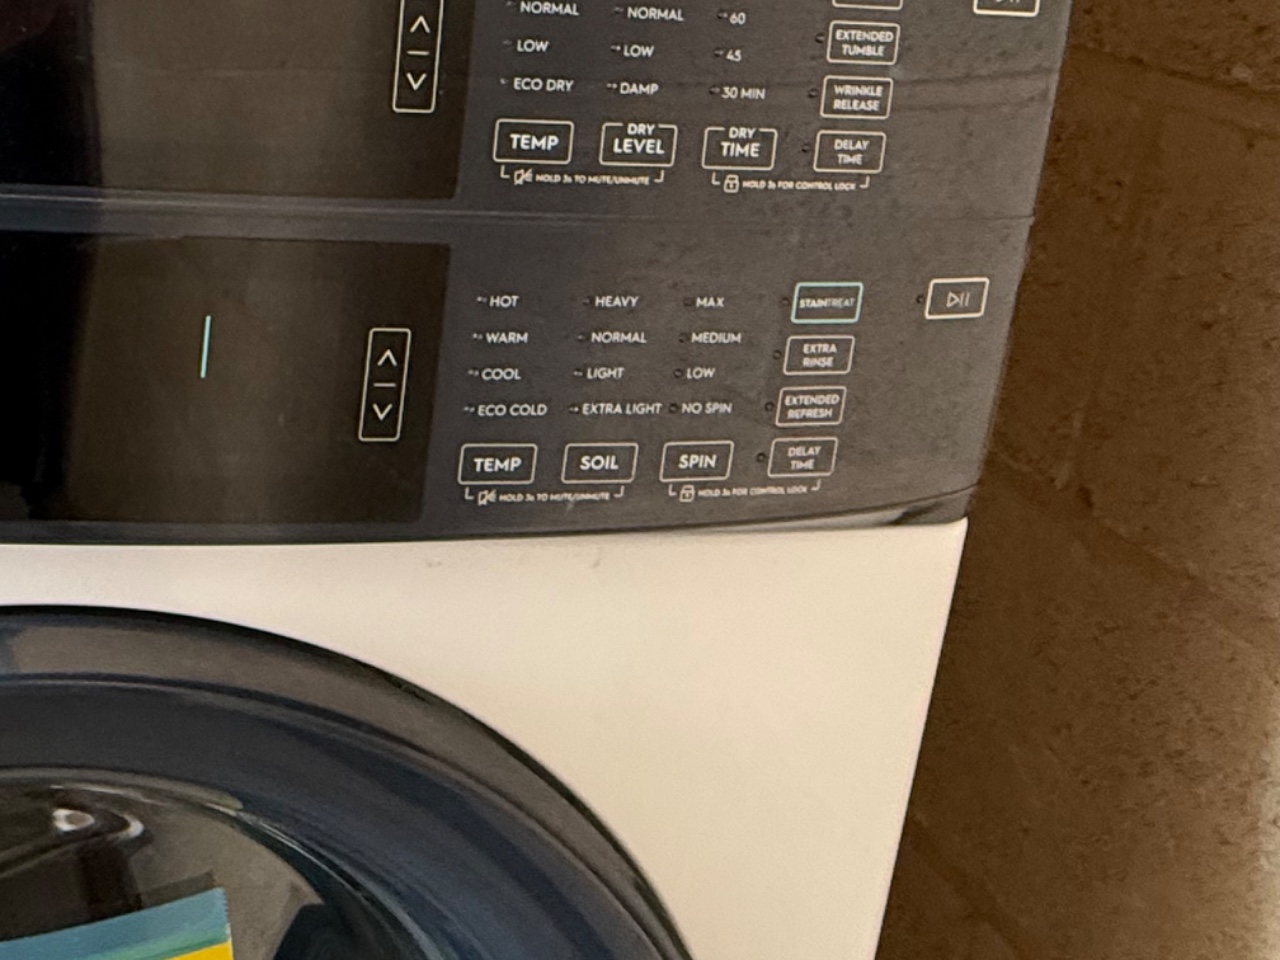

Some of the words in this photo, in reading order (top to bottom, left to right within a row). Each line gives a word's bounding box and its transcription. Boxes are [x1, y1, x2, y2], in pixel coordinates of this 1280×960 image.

[520, 1, 580, 16] NORMAL
[627, 7, 684, 21] NORMAL
[729, 12, 746, 25] 60
[835, 30, 894, 43] EXTENDED
[516, 39, 549, 52] LOW
[623, 44, 655, 57] LOW
[842, 44, 884, 56] TUMBLE
[726, 50, 742, 62] 45
[513, 77, 542, 91] ECO
[546, 79, 574, 92] DRY
[620, 83, 659, 95] DAMP
[834, 84, 883, 97] WRINKLE
[721, 86, 738, 99] 30
[741, 87, 765, 99] MIN
[833, 98, 879, 111] RELEASE
[627, 123, 655, 135] DRY
[729, 127, 756, 139] DRY
[509, 133, 559, 150] TEMP
[613, 138, 665, 154] LEVEL
[834, 139, 869, 151] DELAY
[721, 142, 760, 157] TIME
[837, 153, 862, 165] TIME
[489, 296, 518, 308] HOT
[595, 296, 639, 308] HEAVY
[696, 297, 724, 308] MAX
[486, 332, 528, 344] WARM
[591, 332, 647, 344] NORMAL
[691, 332, 741, 344] MEDIUM
[803, 343, 837, 355] EXTRA
[803, 357, 834, 368] RINSE
[481, 368, 521, 381] COOL
[586, 368, 624, 380] LIGHT
[687, 367, 715, 379] LOW
[785, 394, 839, 407] EXTENDED
[478, 404, 507, 417] ECO
[510, 404, 548, 416] COLD
[582, 403, 623, 415] EXTRA
[626, 403, 662, 415] LIGHT
[681, 402, 703, 415] NO
[706, 402, 732, 414] SPIN
[787, 408, 833, 419] REFRESH
[788, 446, 821, 457] DELAY
[474, 457, 522, 472] TEMP
[580, 456, 619, 471] SOIL
[679, 454, 717, 469] SPIN
[791, 459, 814, 470] TIME
